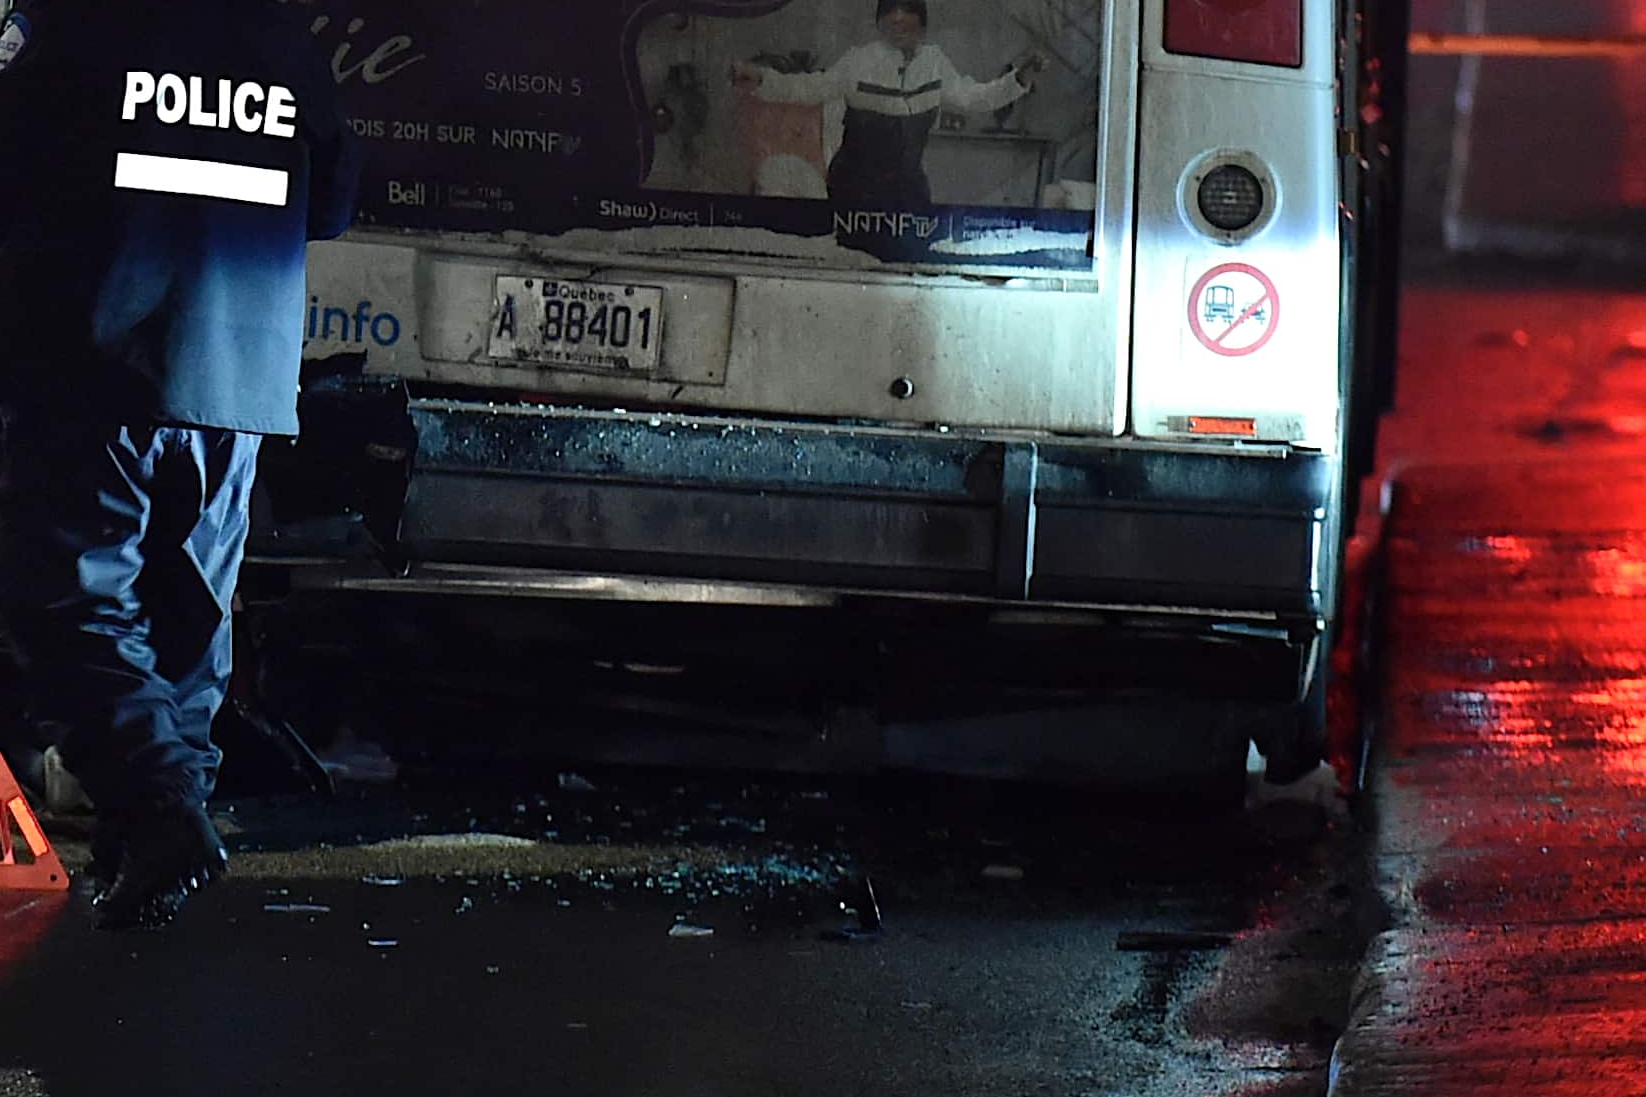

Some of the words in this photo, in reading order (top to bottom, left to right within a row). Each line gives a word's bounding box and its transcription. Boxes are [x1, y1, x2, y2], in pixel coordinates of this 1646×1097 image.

[483, 71, 563, 96] SAISON
[570, 76, 582, 97] 5
[122, 71, 297, 138] POLICE
[346, 118, 386, 137] DIS
[394, 120, 429, 142] 20H
[436, 123, 476, 145] SUR
[387, 181, 425, 206] Bell
[308, 295, 401, 346] info
[496, 294, 515, 338] A
[544, 300, 651, 350] 88401
